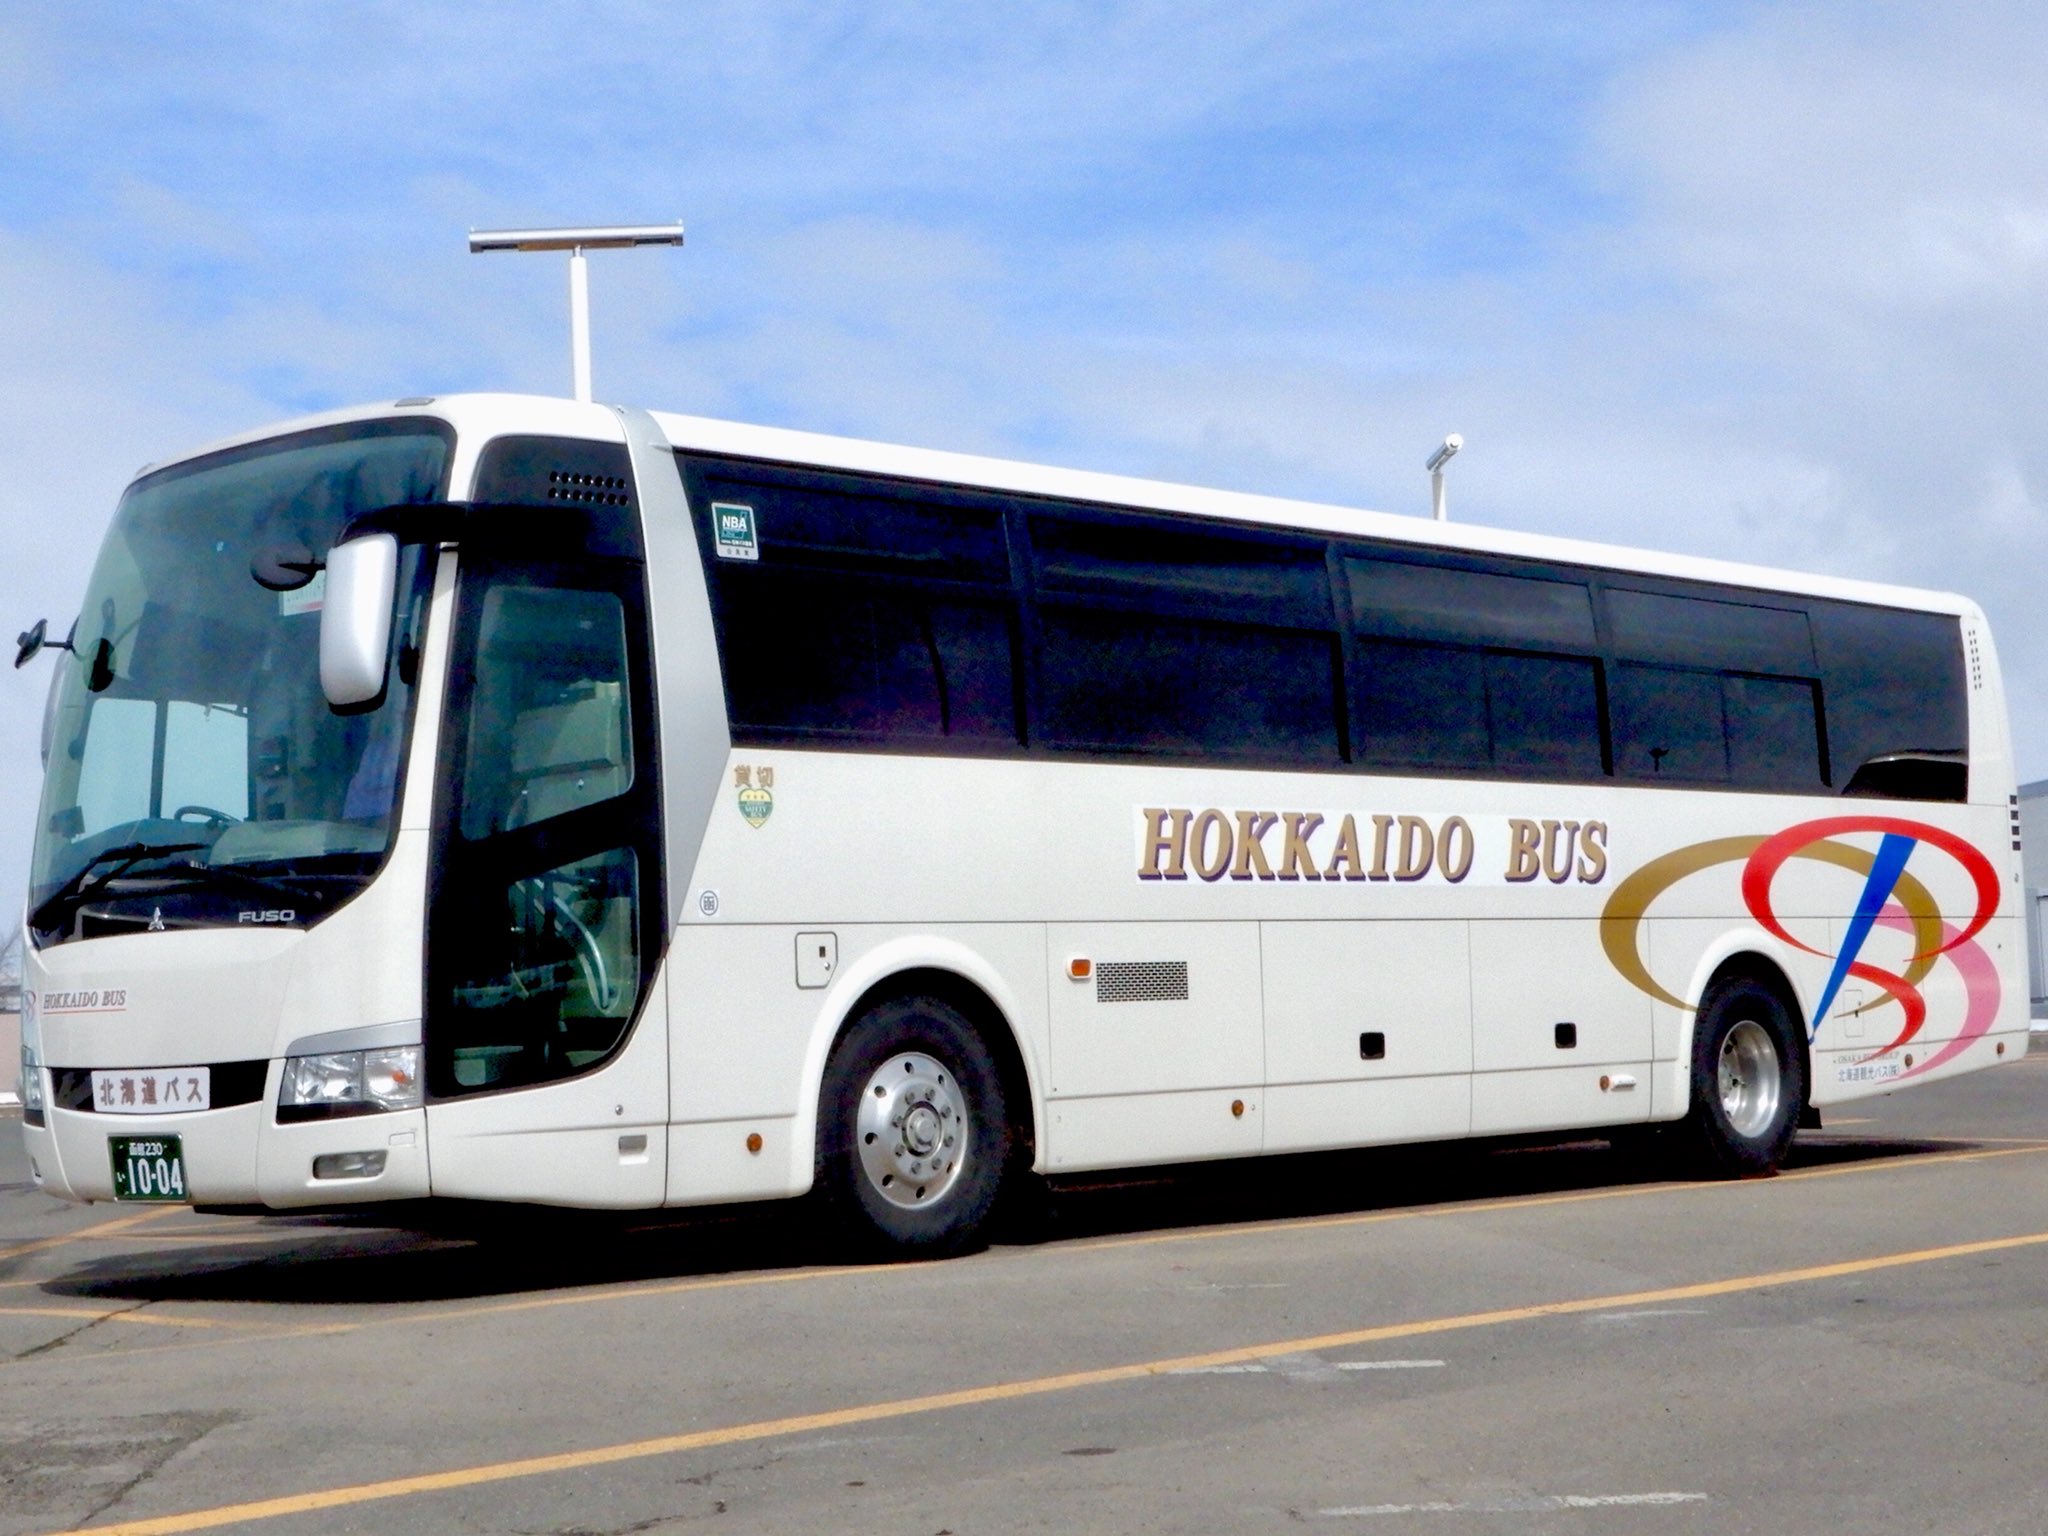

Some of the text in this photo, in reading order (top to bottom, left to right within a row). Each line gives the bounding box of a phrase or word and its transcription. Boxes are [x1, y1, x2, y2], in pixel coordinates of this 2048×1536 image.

[722, 515, 748, 530] NBA
[1137, 808, 1608, 884] HOKKAIDO BUS
[239, 909, 296, 923] FUSO
[43, 990, 127, 1009] HOKKAIDO BUS
[100, 1076, 203, 1106] 北海道バス
